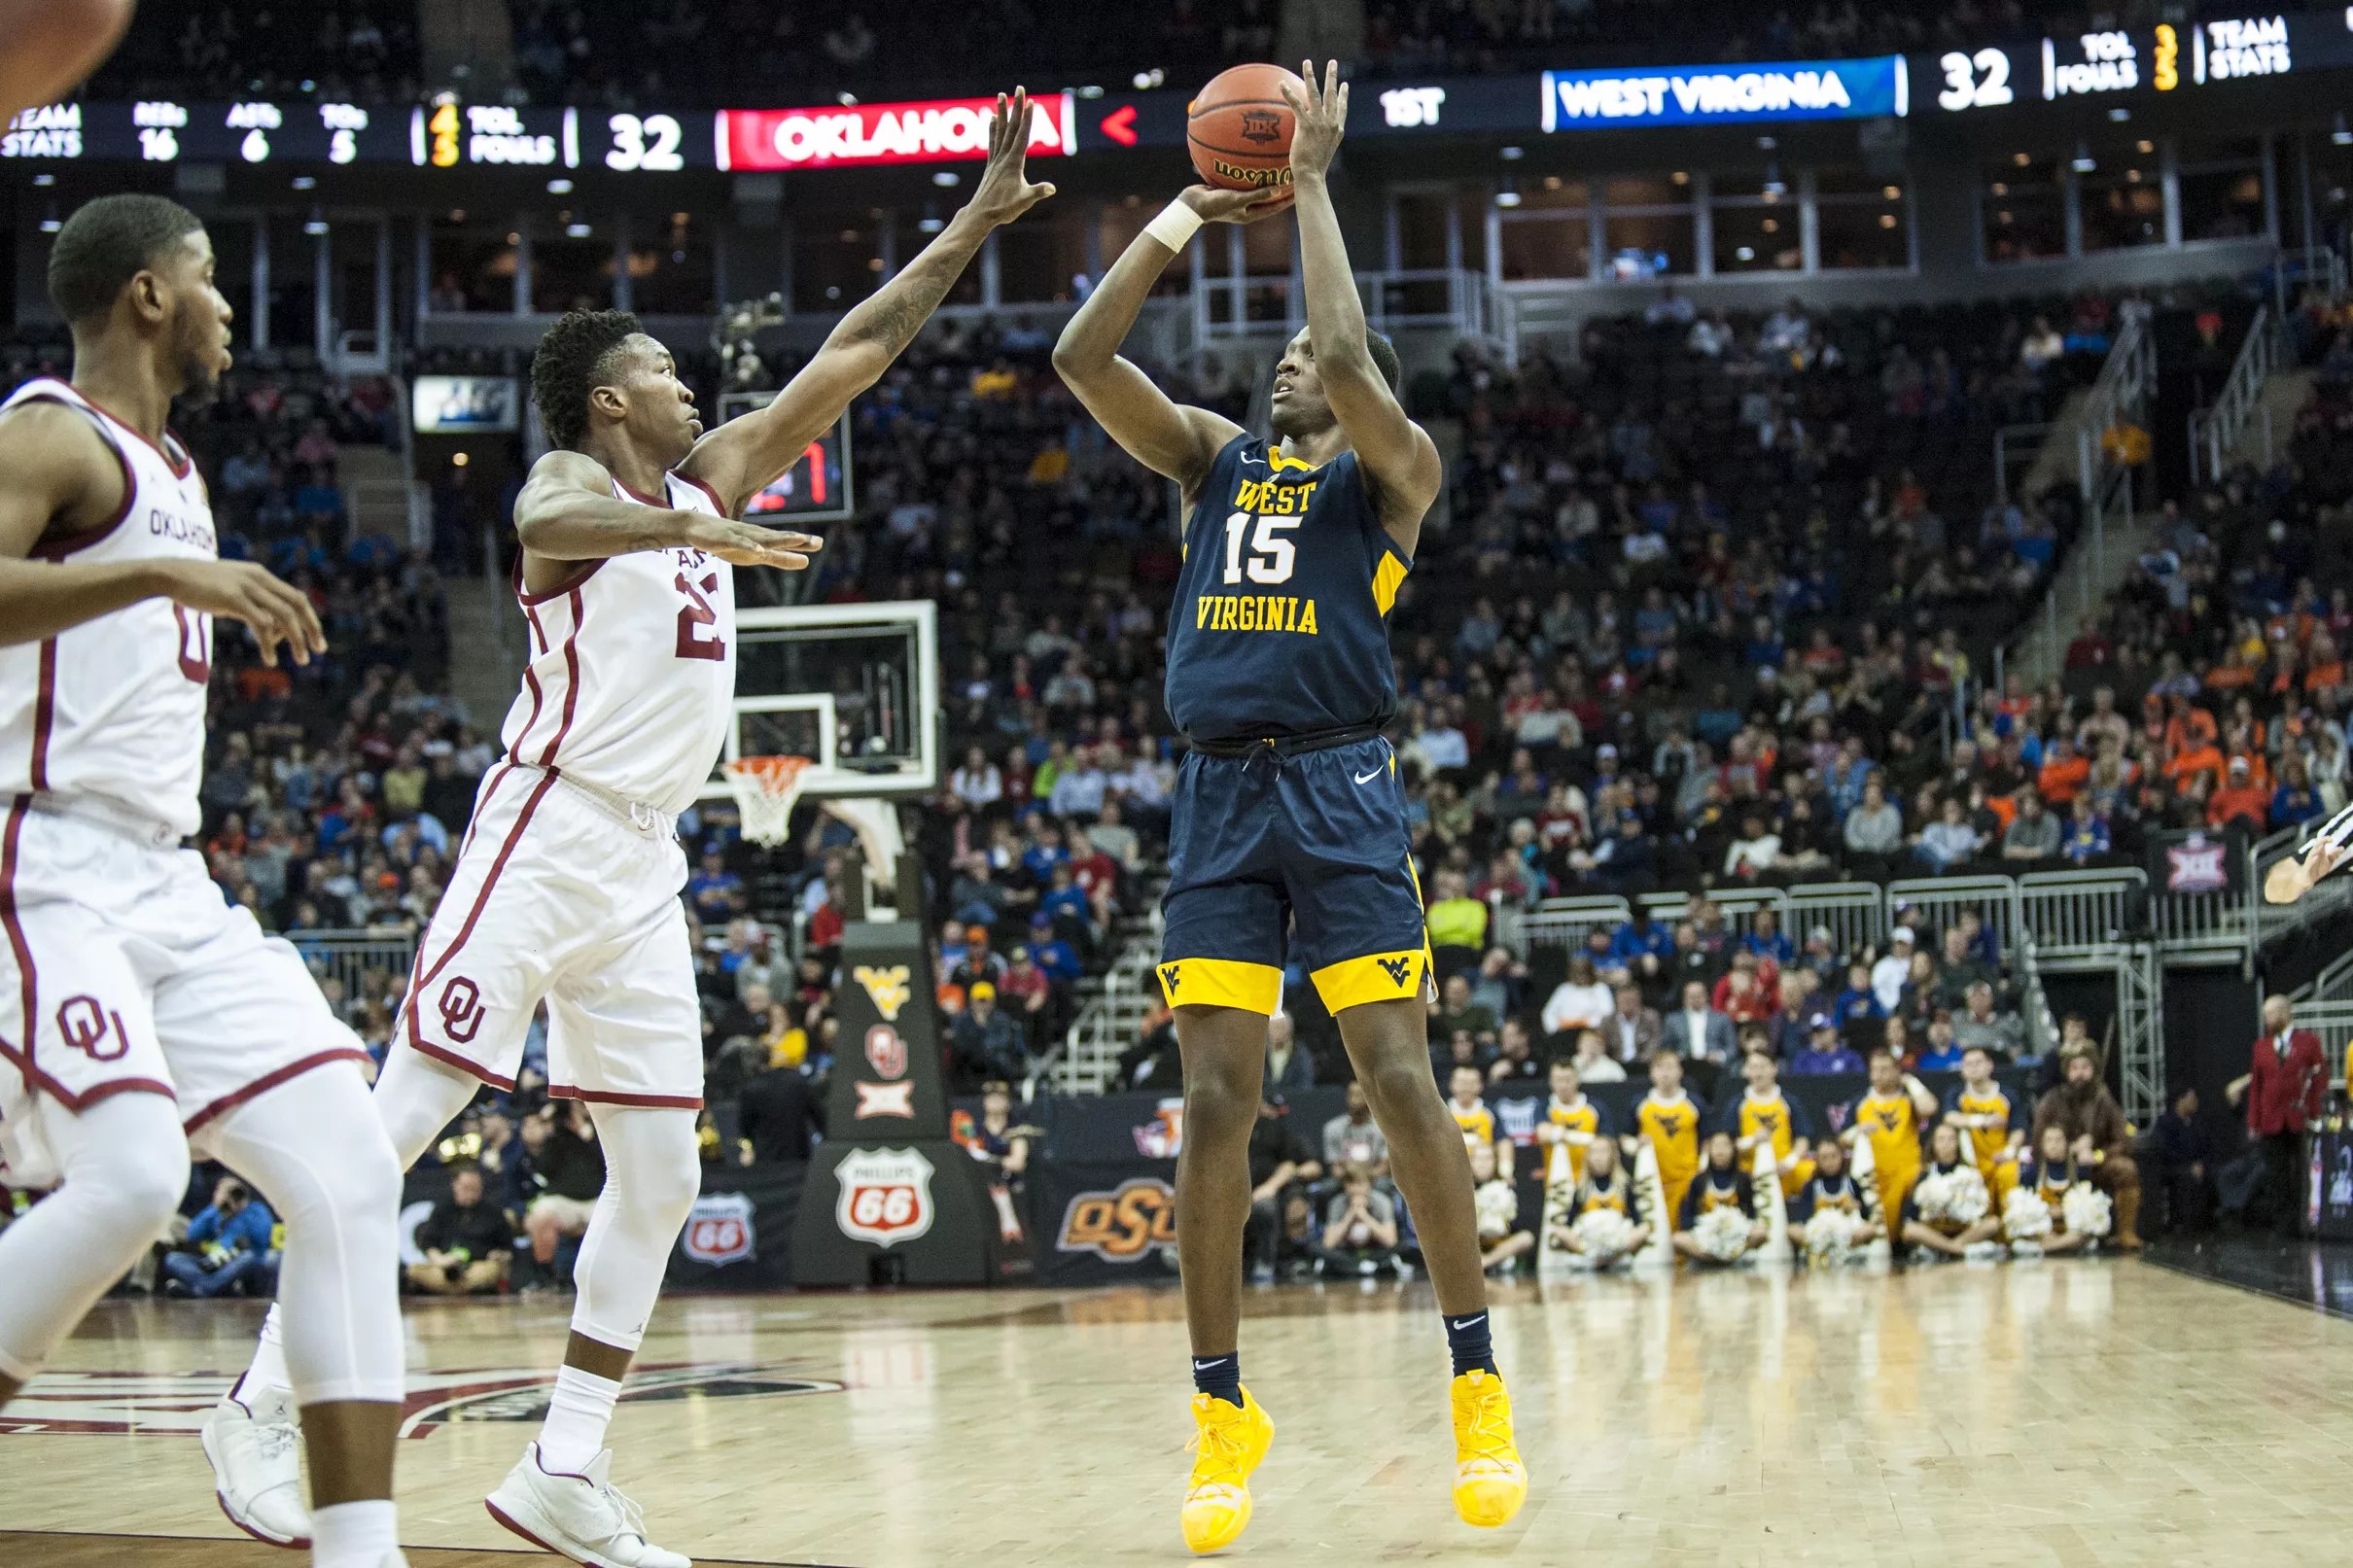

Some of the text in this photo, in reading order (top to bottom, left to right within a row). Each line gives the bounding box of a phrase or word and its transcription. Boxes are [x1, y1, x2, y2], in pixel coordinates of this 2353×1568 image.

[2208, 15, 2288, 49] TEAM
[1939, 48, 2013, 111] 32
[2055, 59, 2138, 94] FOULS
[2209, 45, 2291, 79] STATS
[1380, 87, 1445, 126] 1ST
[1559, 70, 1850, 118] WEST VIRGINIA
[0, 129, 83, 157] STATS
[138, 127, 178, 161] 16
[241, 128, 269, 163] 6
[329, 128, 356, 164] 5
[606, 114, 684, 171] 32
[774, 103, 1060, 162] OKLAHOA
[1235, 479, 1317, 513] WEST
[1223, 511, 1303, 585] 15
[1197, 595, 1317, 635] VIRGINIA
[56, 993, 129, 1063] OU
[439, 976, 486, 1044] OU
[856, 1187, 914, 1225] 66
[696, 1222, 740, 1249] 66
